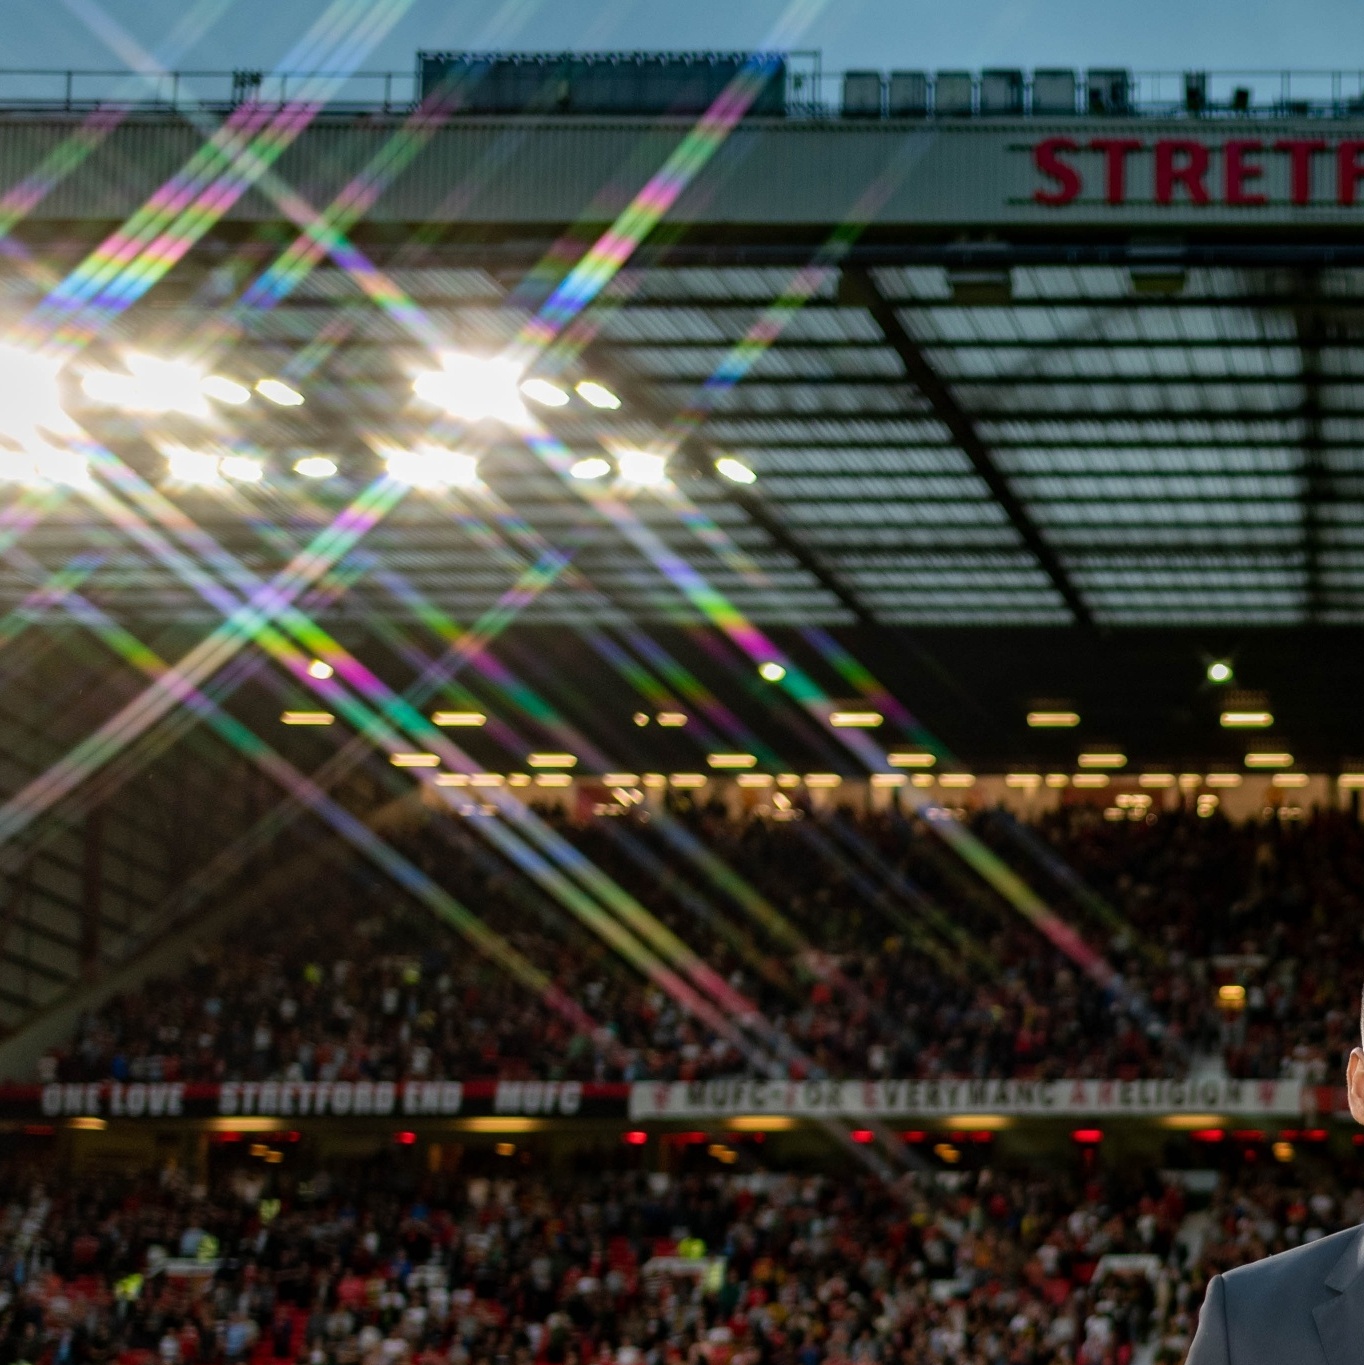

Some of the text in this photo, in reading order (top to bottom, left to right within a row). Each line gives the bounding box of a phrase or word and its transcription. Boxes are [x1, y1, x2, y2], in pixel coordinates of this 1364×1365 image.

[42, 1082, 102, 1116] ONE
[109, 1082, 185, 1116] LOVE
[403, 1081, 463, 1115] END
